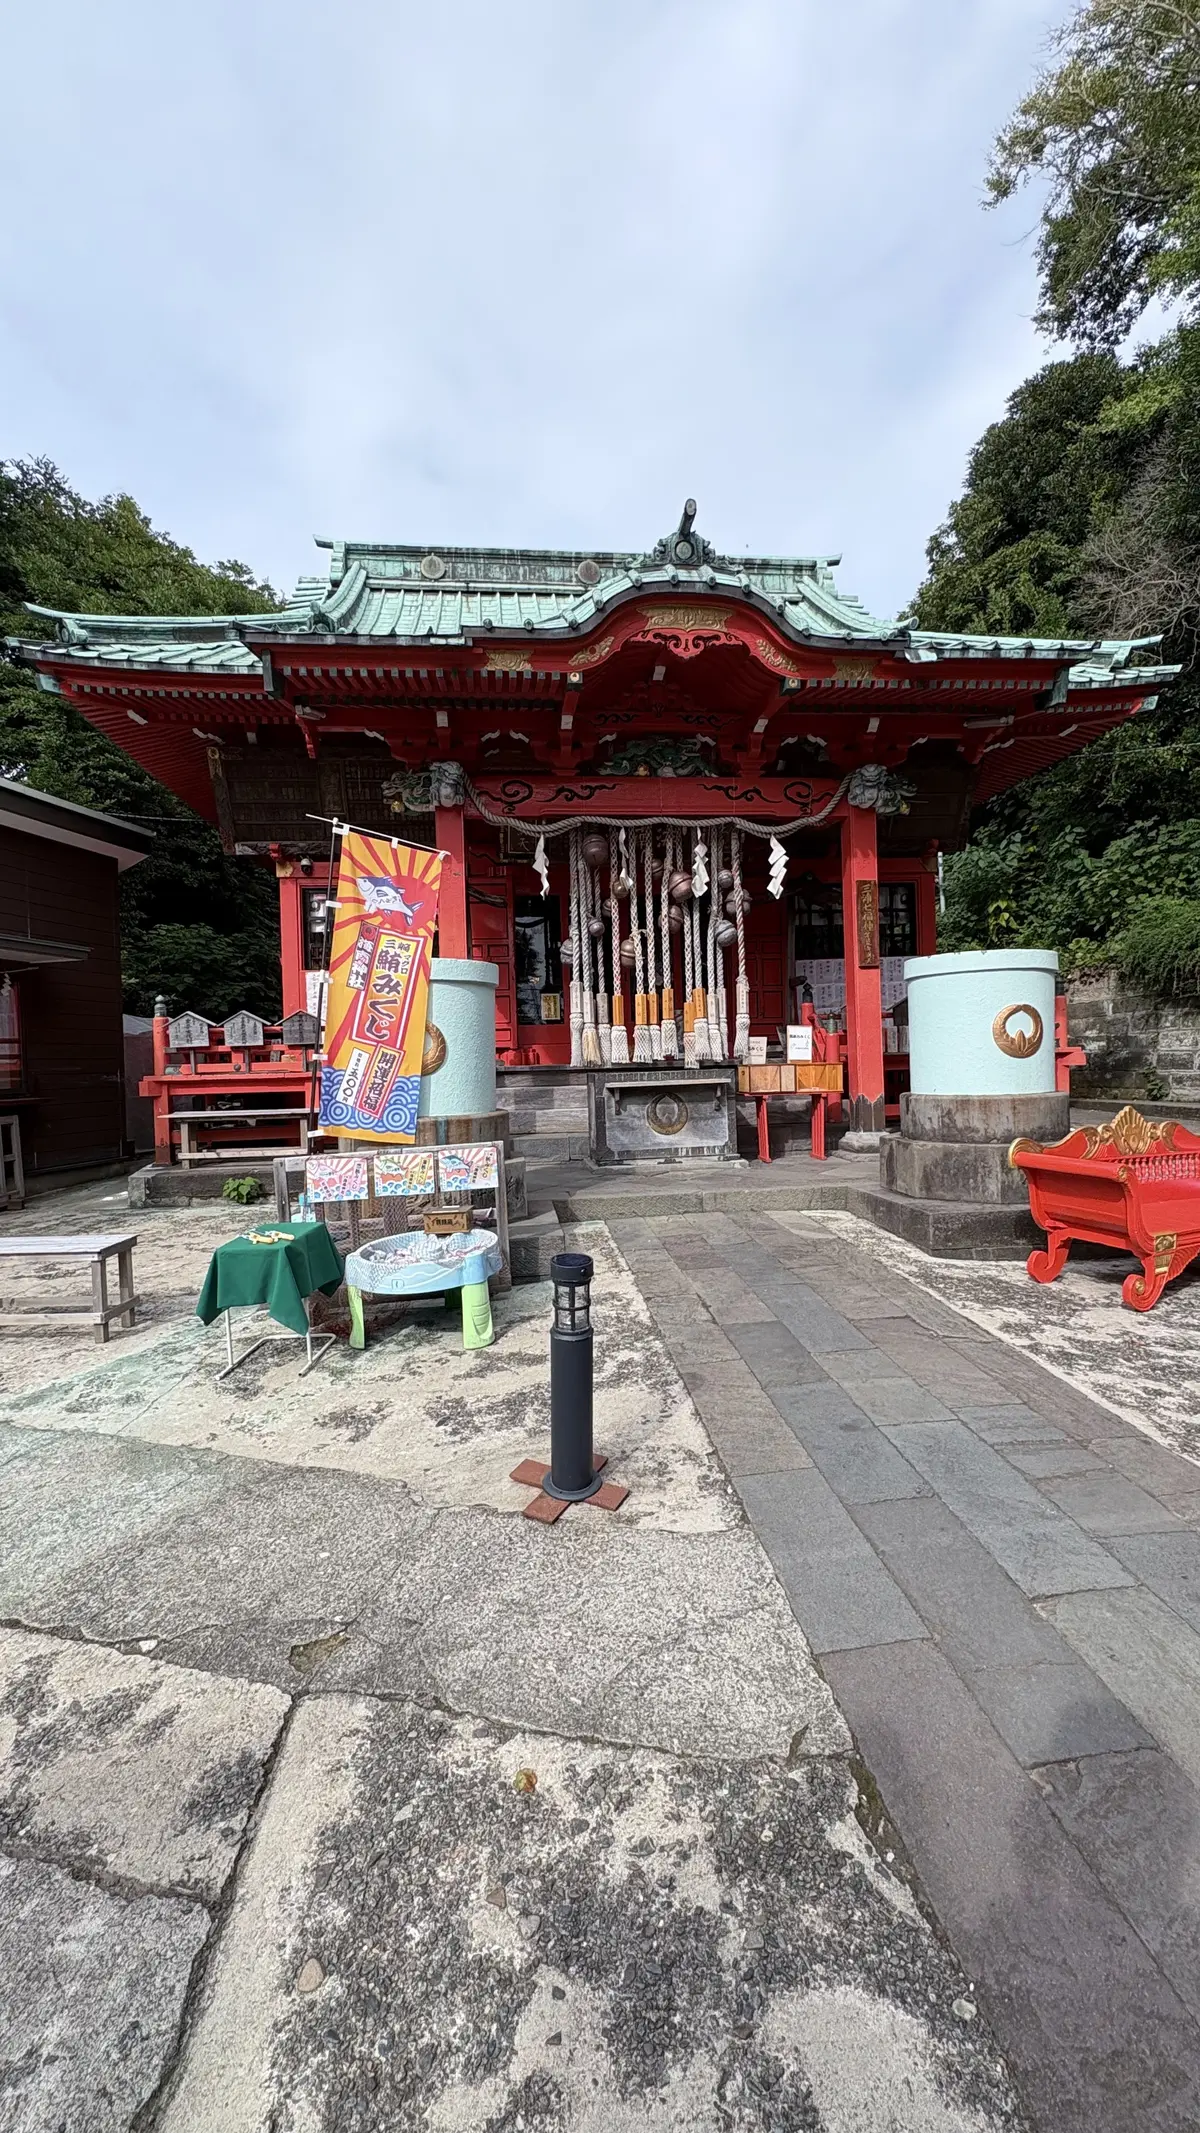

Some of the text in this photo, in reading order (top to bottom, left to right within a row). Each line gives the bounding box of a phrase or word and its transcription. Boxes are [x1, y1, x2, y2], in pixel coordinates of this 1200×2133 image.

[365, 949, 403, 1040] 鮪みくじ
[362, 1051, 397, 1111] 開運招福
